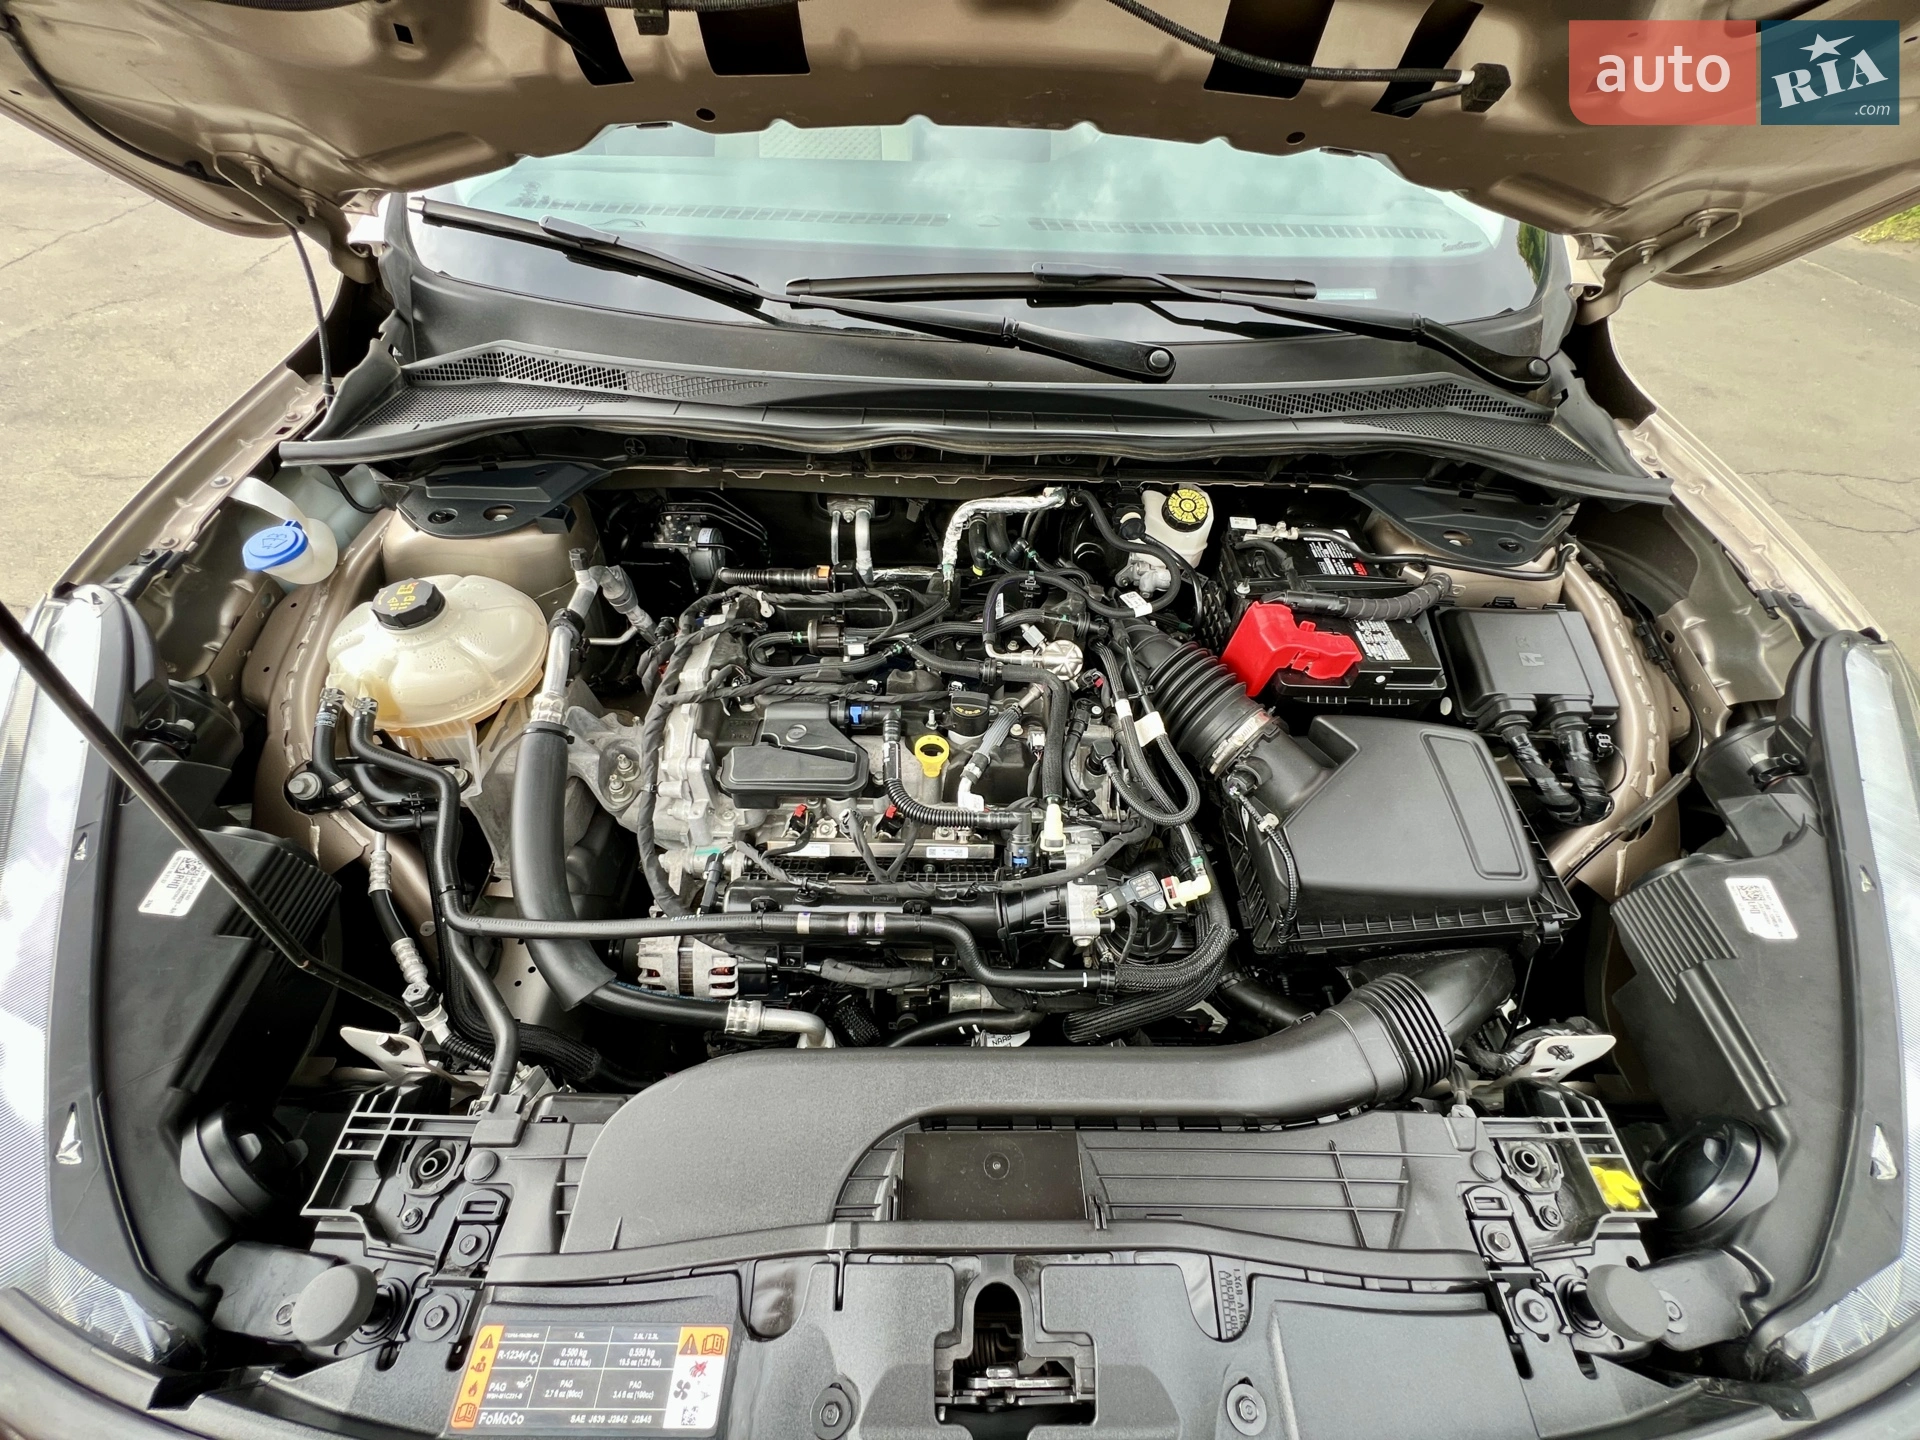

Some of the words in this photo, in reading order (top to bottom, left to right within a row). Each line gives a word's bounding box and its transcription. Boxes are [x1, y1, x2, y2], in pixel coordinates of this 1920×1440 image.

[497, 1350, 531, 1361] R-1234yf
[561, 1348, 579, 1357] 0.500
[579, 1348, 588, 1358] kg
[646, 1348, 655, 1358] kg
[489, 1382, 507, 1392] PAG
[560, 1380, 573, 1388] PAG
[478, 1412, 525, 1425] FoMoCo
[570, 1415, 585, 1424] SAE
